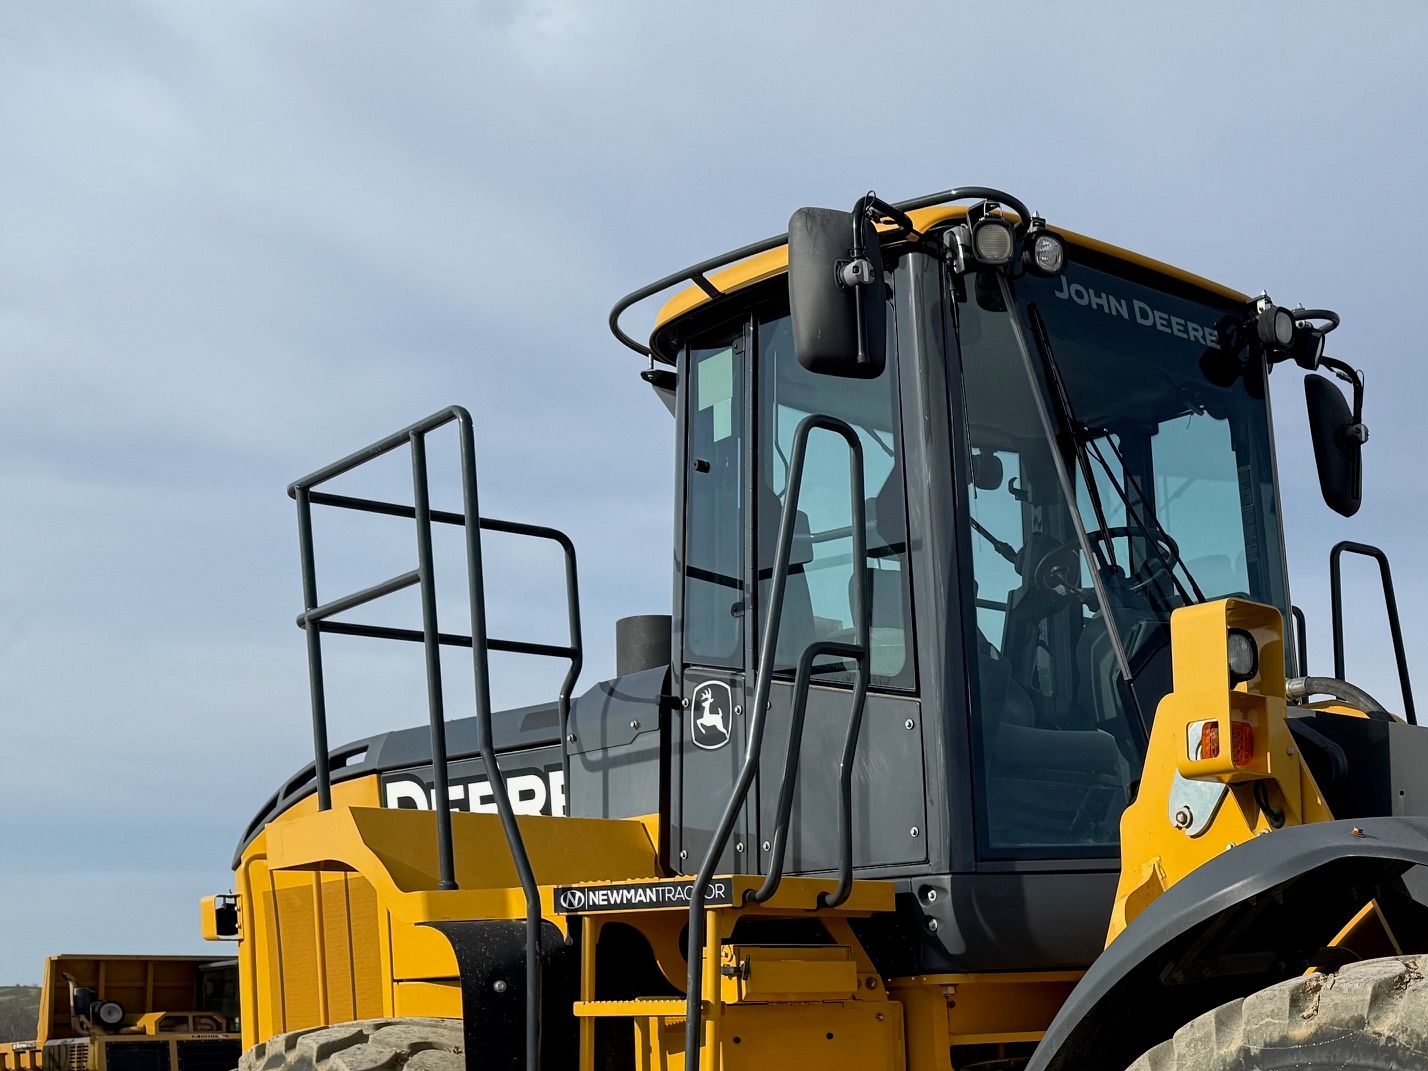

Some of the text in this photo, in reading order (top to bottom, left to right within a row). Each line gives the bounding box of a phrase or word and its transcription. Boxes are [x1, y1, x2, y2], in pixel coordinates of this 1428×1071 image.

[1054, 275, 1221, 350] JOHN DEERE
[589, 883, 725, 906] NEWMANTRACOR
